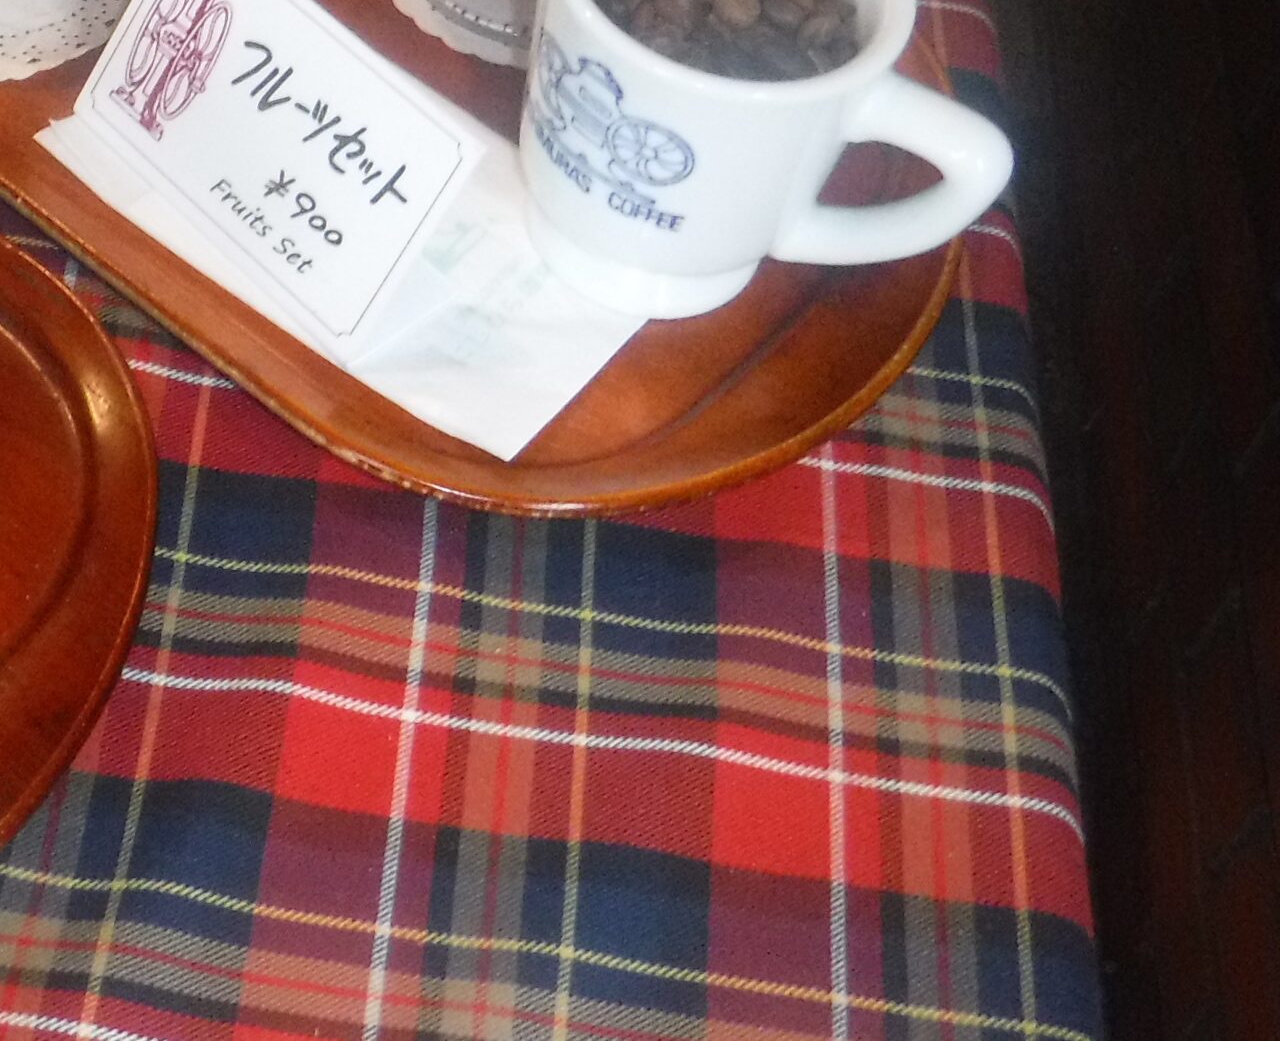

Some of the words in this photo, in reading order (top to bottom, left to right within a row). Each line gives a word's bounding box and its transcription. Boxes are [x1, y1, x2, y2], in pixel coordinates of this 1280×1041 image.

[231, 40, 408, 207] フルーツセット
[209, 178, 273, 239] Fruits
[272, 237, 313, 274] Set
